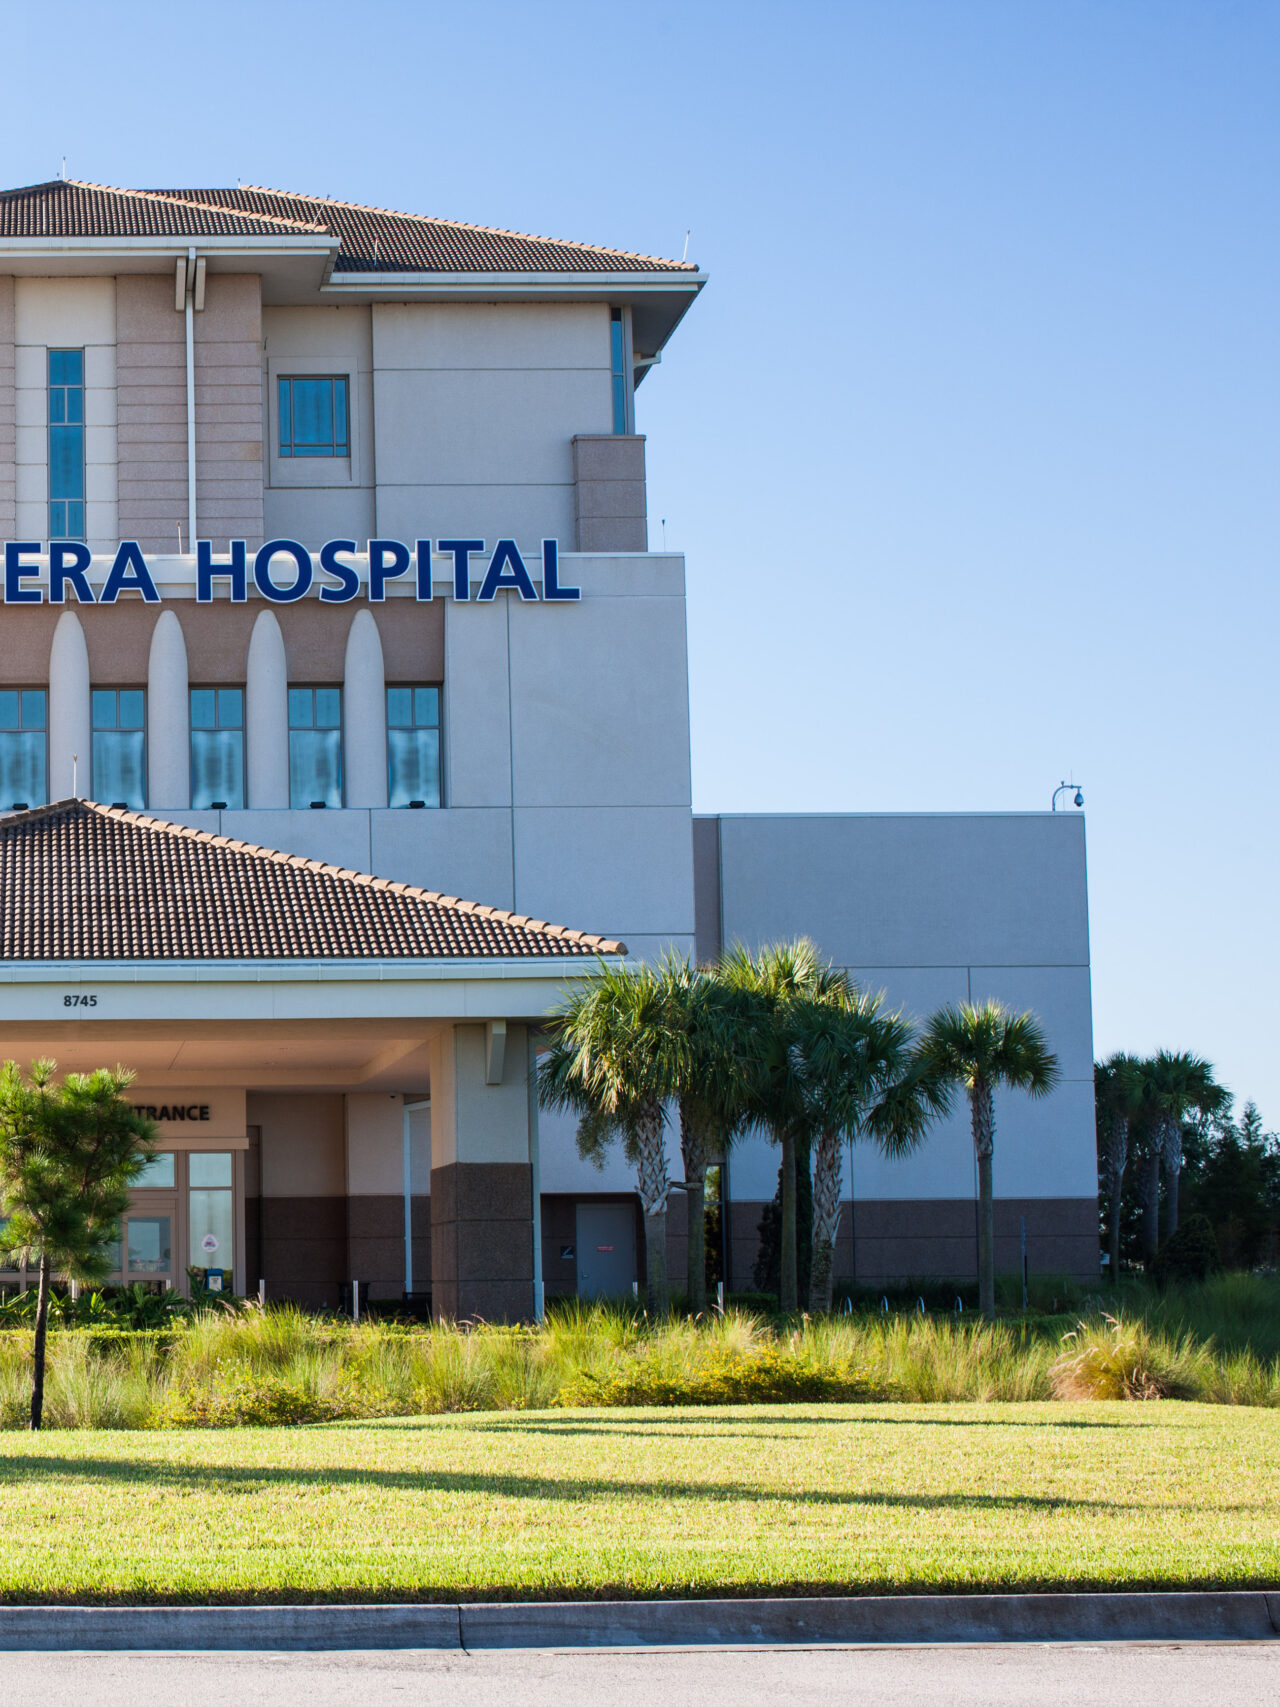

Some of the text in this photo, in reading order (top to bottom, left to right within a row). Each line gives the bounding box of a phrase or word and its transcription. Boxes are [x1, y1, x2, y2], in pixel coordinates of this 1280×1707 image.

[195, 538, 582, 604] HOSPITAL
[63, 994, 98, 1007] 8745
[126, 1104, 210, 1121] TRANCE
